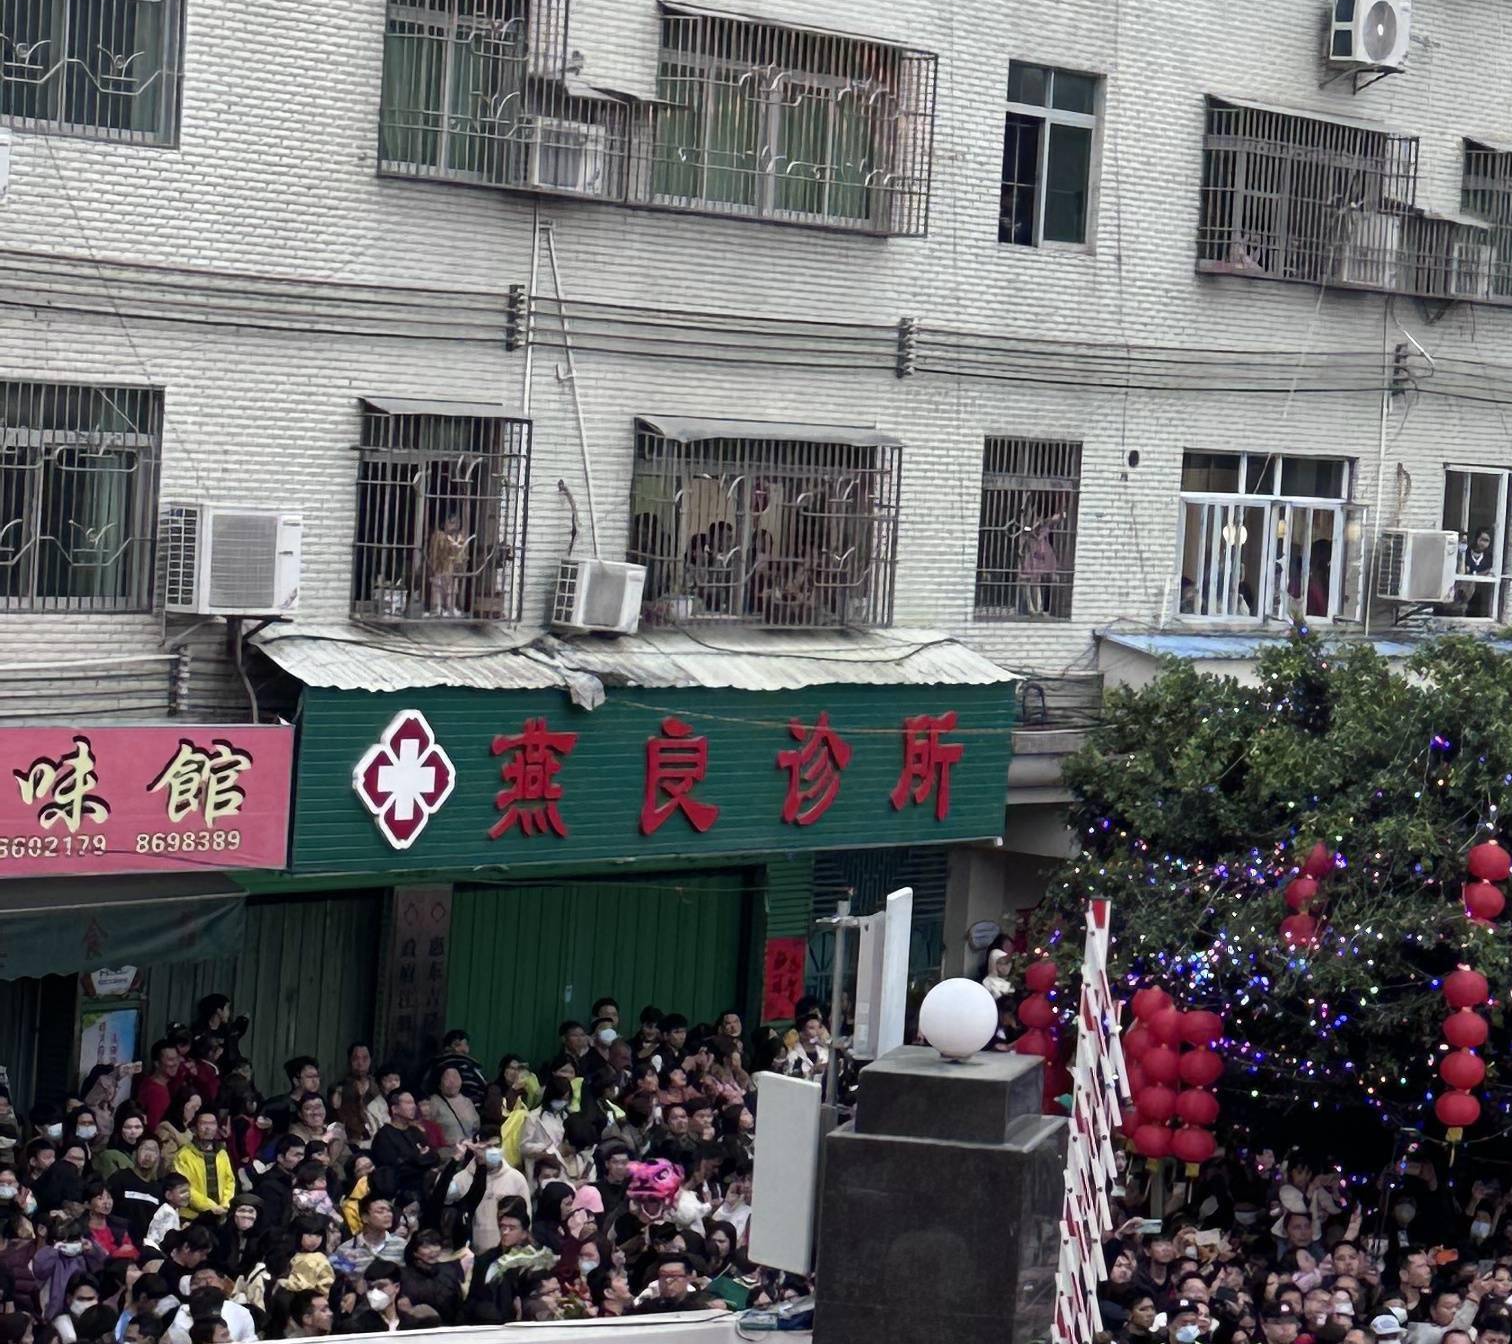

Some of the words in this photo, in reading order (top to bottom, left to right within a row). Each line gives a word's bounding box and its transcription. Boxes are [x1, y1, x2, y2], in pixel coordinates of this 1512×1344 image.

[13, 735, 254, 833] 味館
[486, 710, 965, 840] 燕良诊所
[135, 829, 242, 854] 8698389
